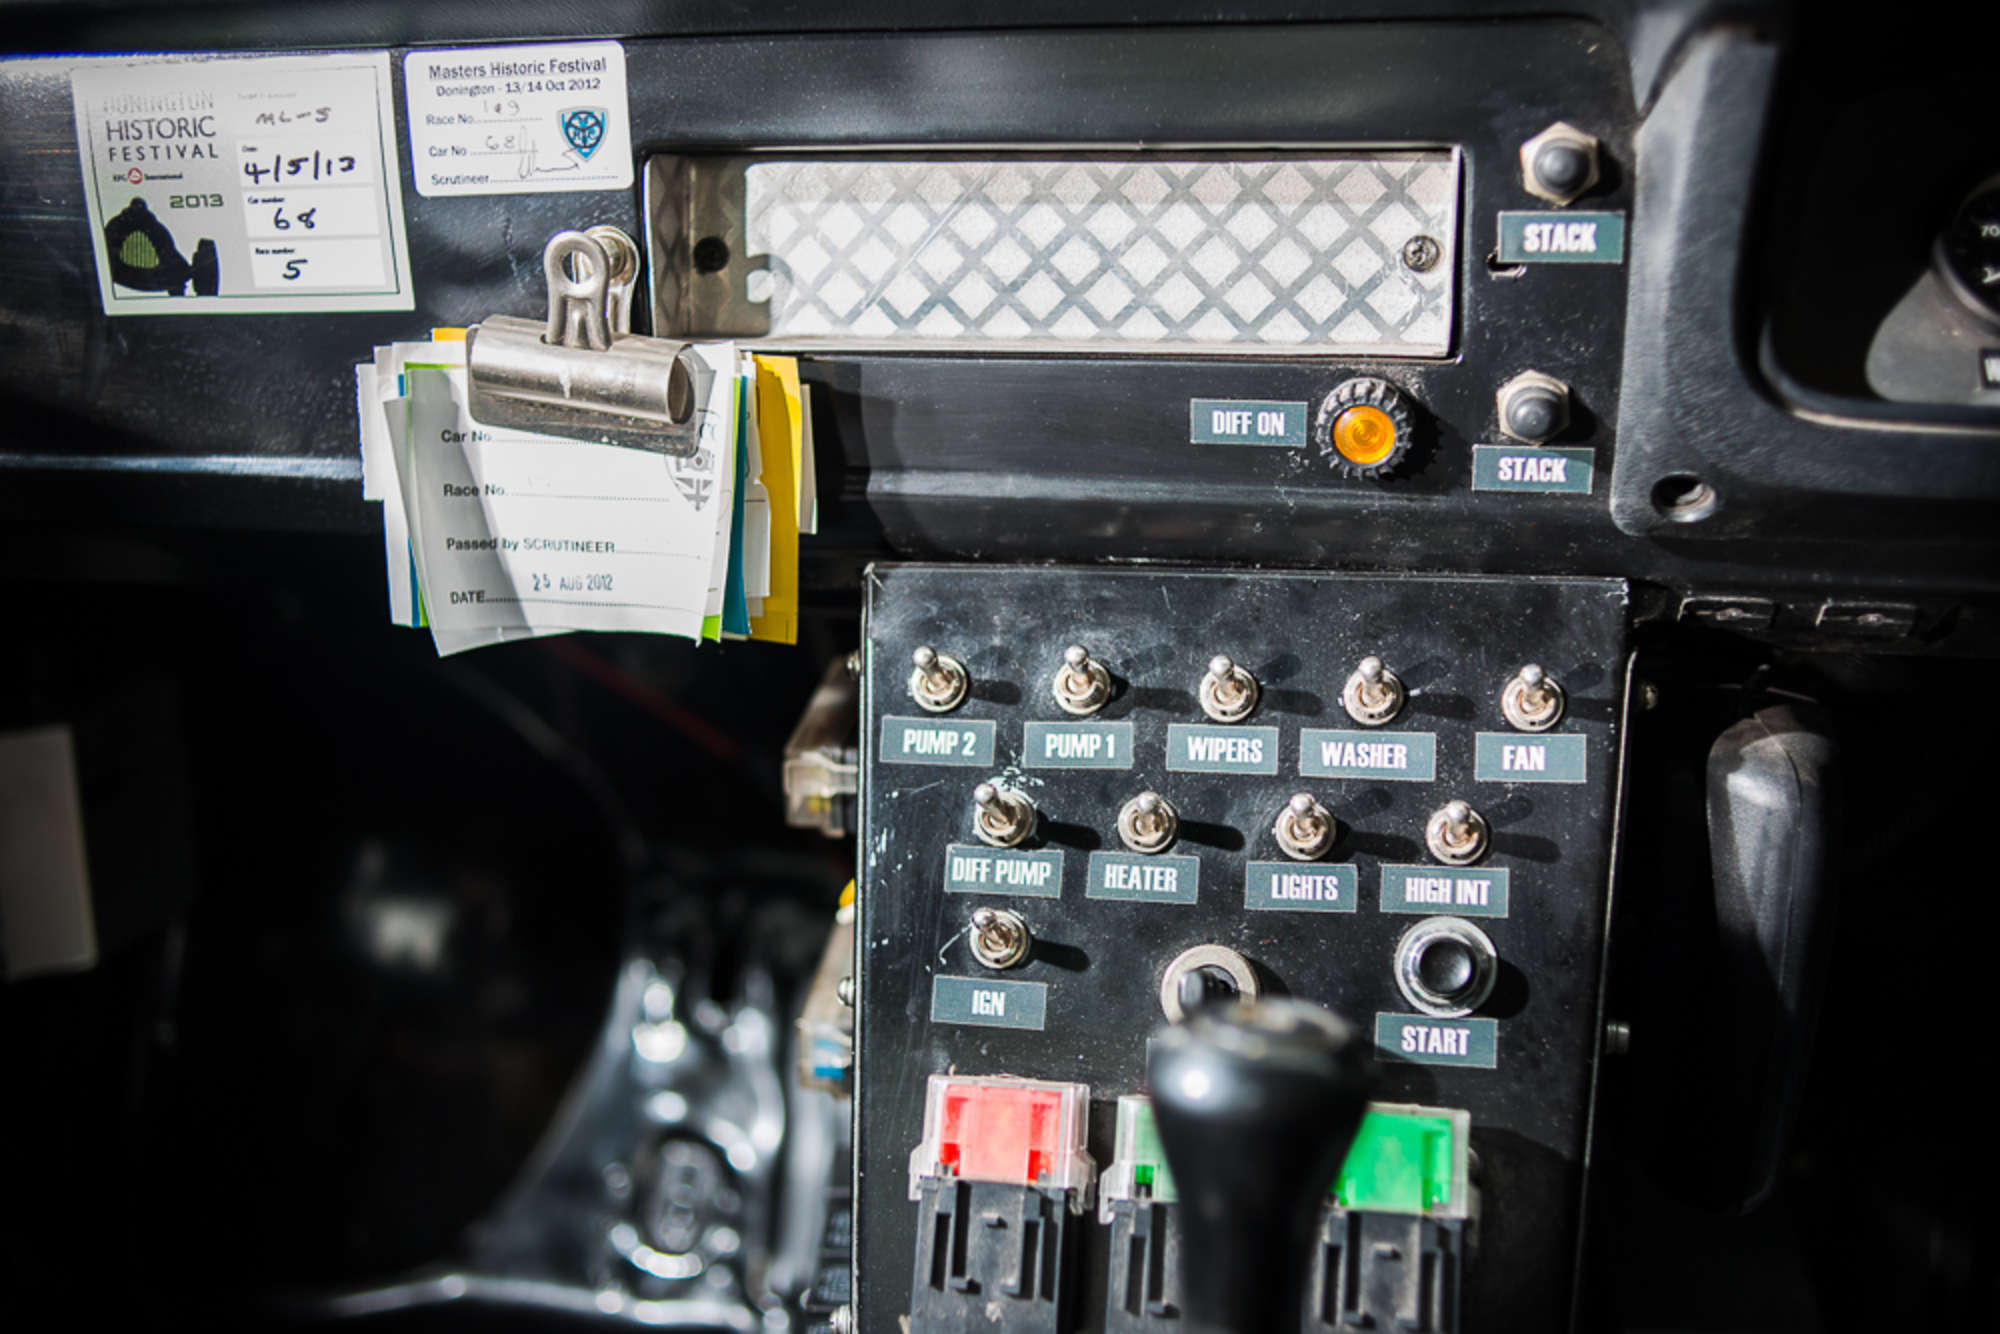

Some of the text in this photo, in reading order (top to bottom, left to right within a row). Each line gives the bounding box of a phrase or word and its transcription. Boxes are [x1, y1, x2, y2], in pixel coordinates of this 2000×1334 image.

[429, 56, 607, 80] Masters Historic Festival
[435, 83, 495, 97] Donington
[545, 79, 565, 92] Oct
[568, 77, 601, 91] 2012
[105, 115, 217, 141] HISTORIC
[426, 112, 455, 125] Race
[108, 143, 219, 162] FESTIVAL
[429, 145, 448, 158] Car
[431, 173, 489, 186] Scrutineer
[169, 193, 224, 209] 2013
[1523, 222, 1598, 254] STACK
[282, 258, 309, 280] 5
[441, 429, 467, 444] Car
[1212, 410, 1286, 437] DIFF ON
[1498, 456, 1568, 484] STACK
[443, 483, 480, 497] Race
[446, 537, 616, 554] Passed by SCRUTINEER
[532, 572, 614, 592] 25 AUG 2012
[450, 589, 487, 605] DATE
[903, 729, 977, 757] PUMP 2
[1045, 733, 1116, 759] PUMP 1
[1188, 736, 1264, 764] WIPERS
[1321, 741, 1408, 770] WASHER
[1502, 745, 1546, 772] FAN
[952, 857, 1052, 887] DIFF PUMP
[1104, 863, 1178, 893] HEATER
[1271, 873, 1340, 901] LIGHTS
[1405, 877, 1492, 907] HIGH INT
[971, 989, 1006, 1018] IGN
[1401, 1024, 1471, 1056] START
